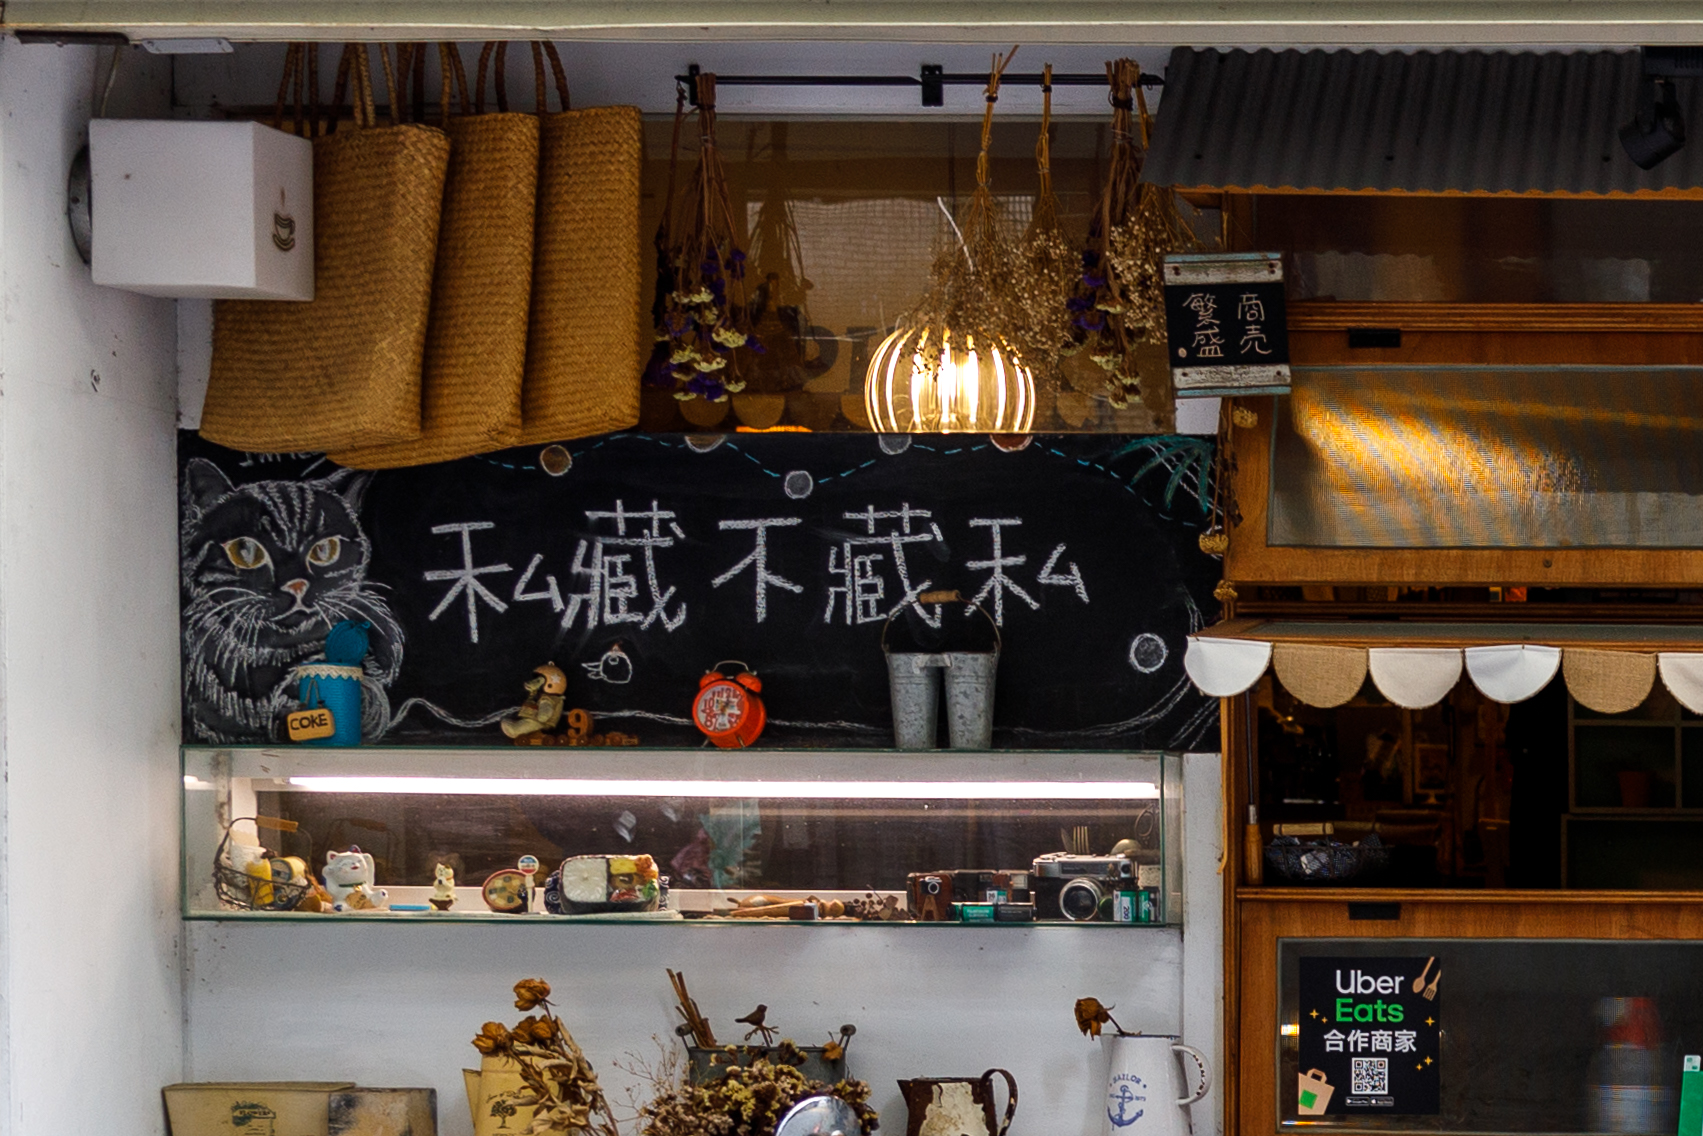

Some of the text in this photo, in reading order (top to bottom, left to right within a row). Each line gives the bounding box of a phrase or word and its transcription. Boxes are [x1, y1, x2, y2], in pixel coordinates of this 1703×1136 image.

[1182, 293, 1225, 357] 繁盛
[1238, 292, 1272, 354] 商売
[290, 713, 329, 731] COKE
[567, 708, 589, 738] 9
[1335, 969, 1405, 994] Uber
[1335, 998, 1405, 1023] Eats
[1323, 1028, 1418, 1053] 合作商家
